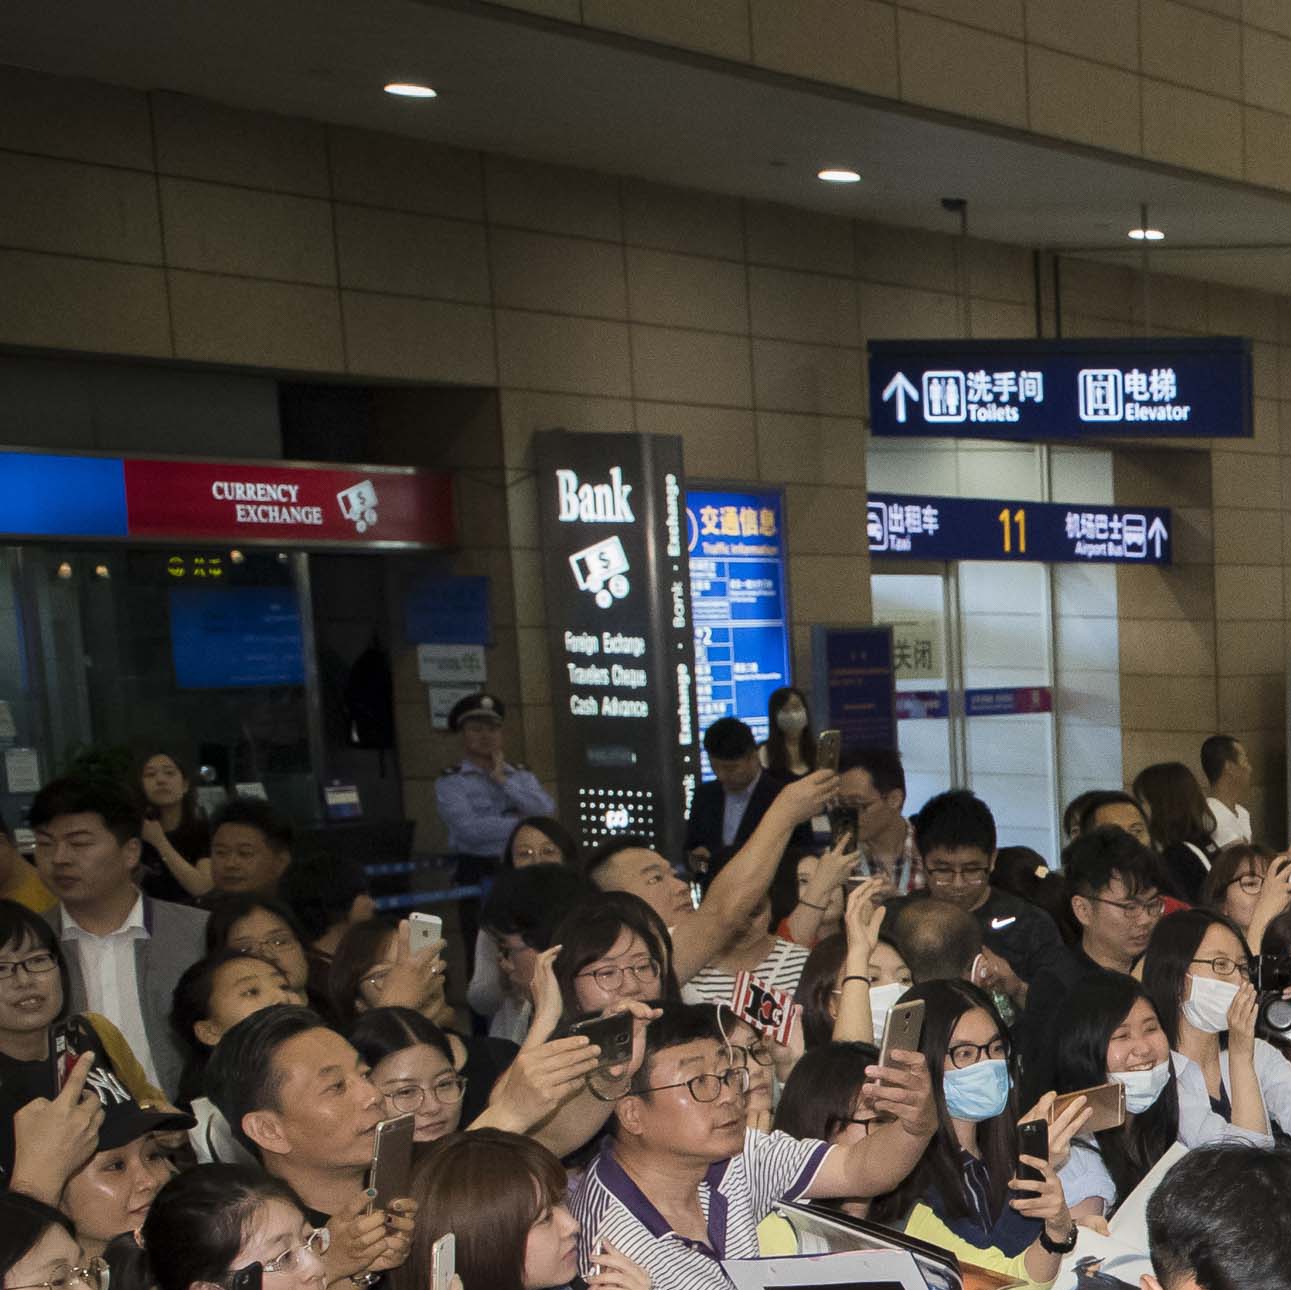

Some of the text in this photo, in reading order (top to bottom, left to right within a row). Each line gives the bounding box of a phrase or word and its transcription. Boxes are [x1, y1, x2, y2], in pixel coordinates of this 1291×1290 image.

[967, 370, 1044, 402] 洗手间
[1124, 368, 1177, 401] 电梯
[967, 403, 1020, 422] Toilets
[1125, 403, 1191, 421] Elevator
[212, 481, 299, 503] CURRENCY
[555, 466, 636, 523] Bank
[236, 504, 323, 525] EXCHANGE
[665, 473, 681, 557] Exchange
[700, 505, 776, 537] 交通信息
[888, 504, 940, 536] 出租车
[998, 508, 1026, 553] 11
[1065, 511, 1123, 541] 机场巴士
[671, 580, 687, 629] Bank
[564, 631, 646, 658] Foreign Exchange
[570, 694, 649, 718] Cash Advance
[676, 662, 693, 746] Exchange
